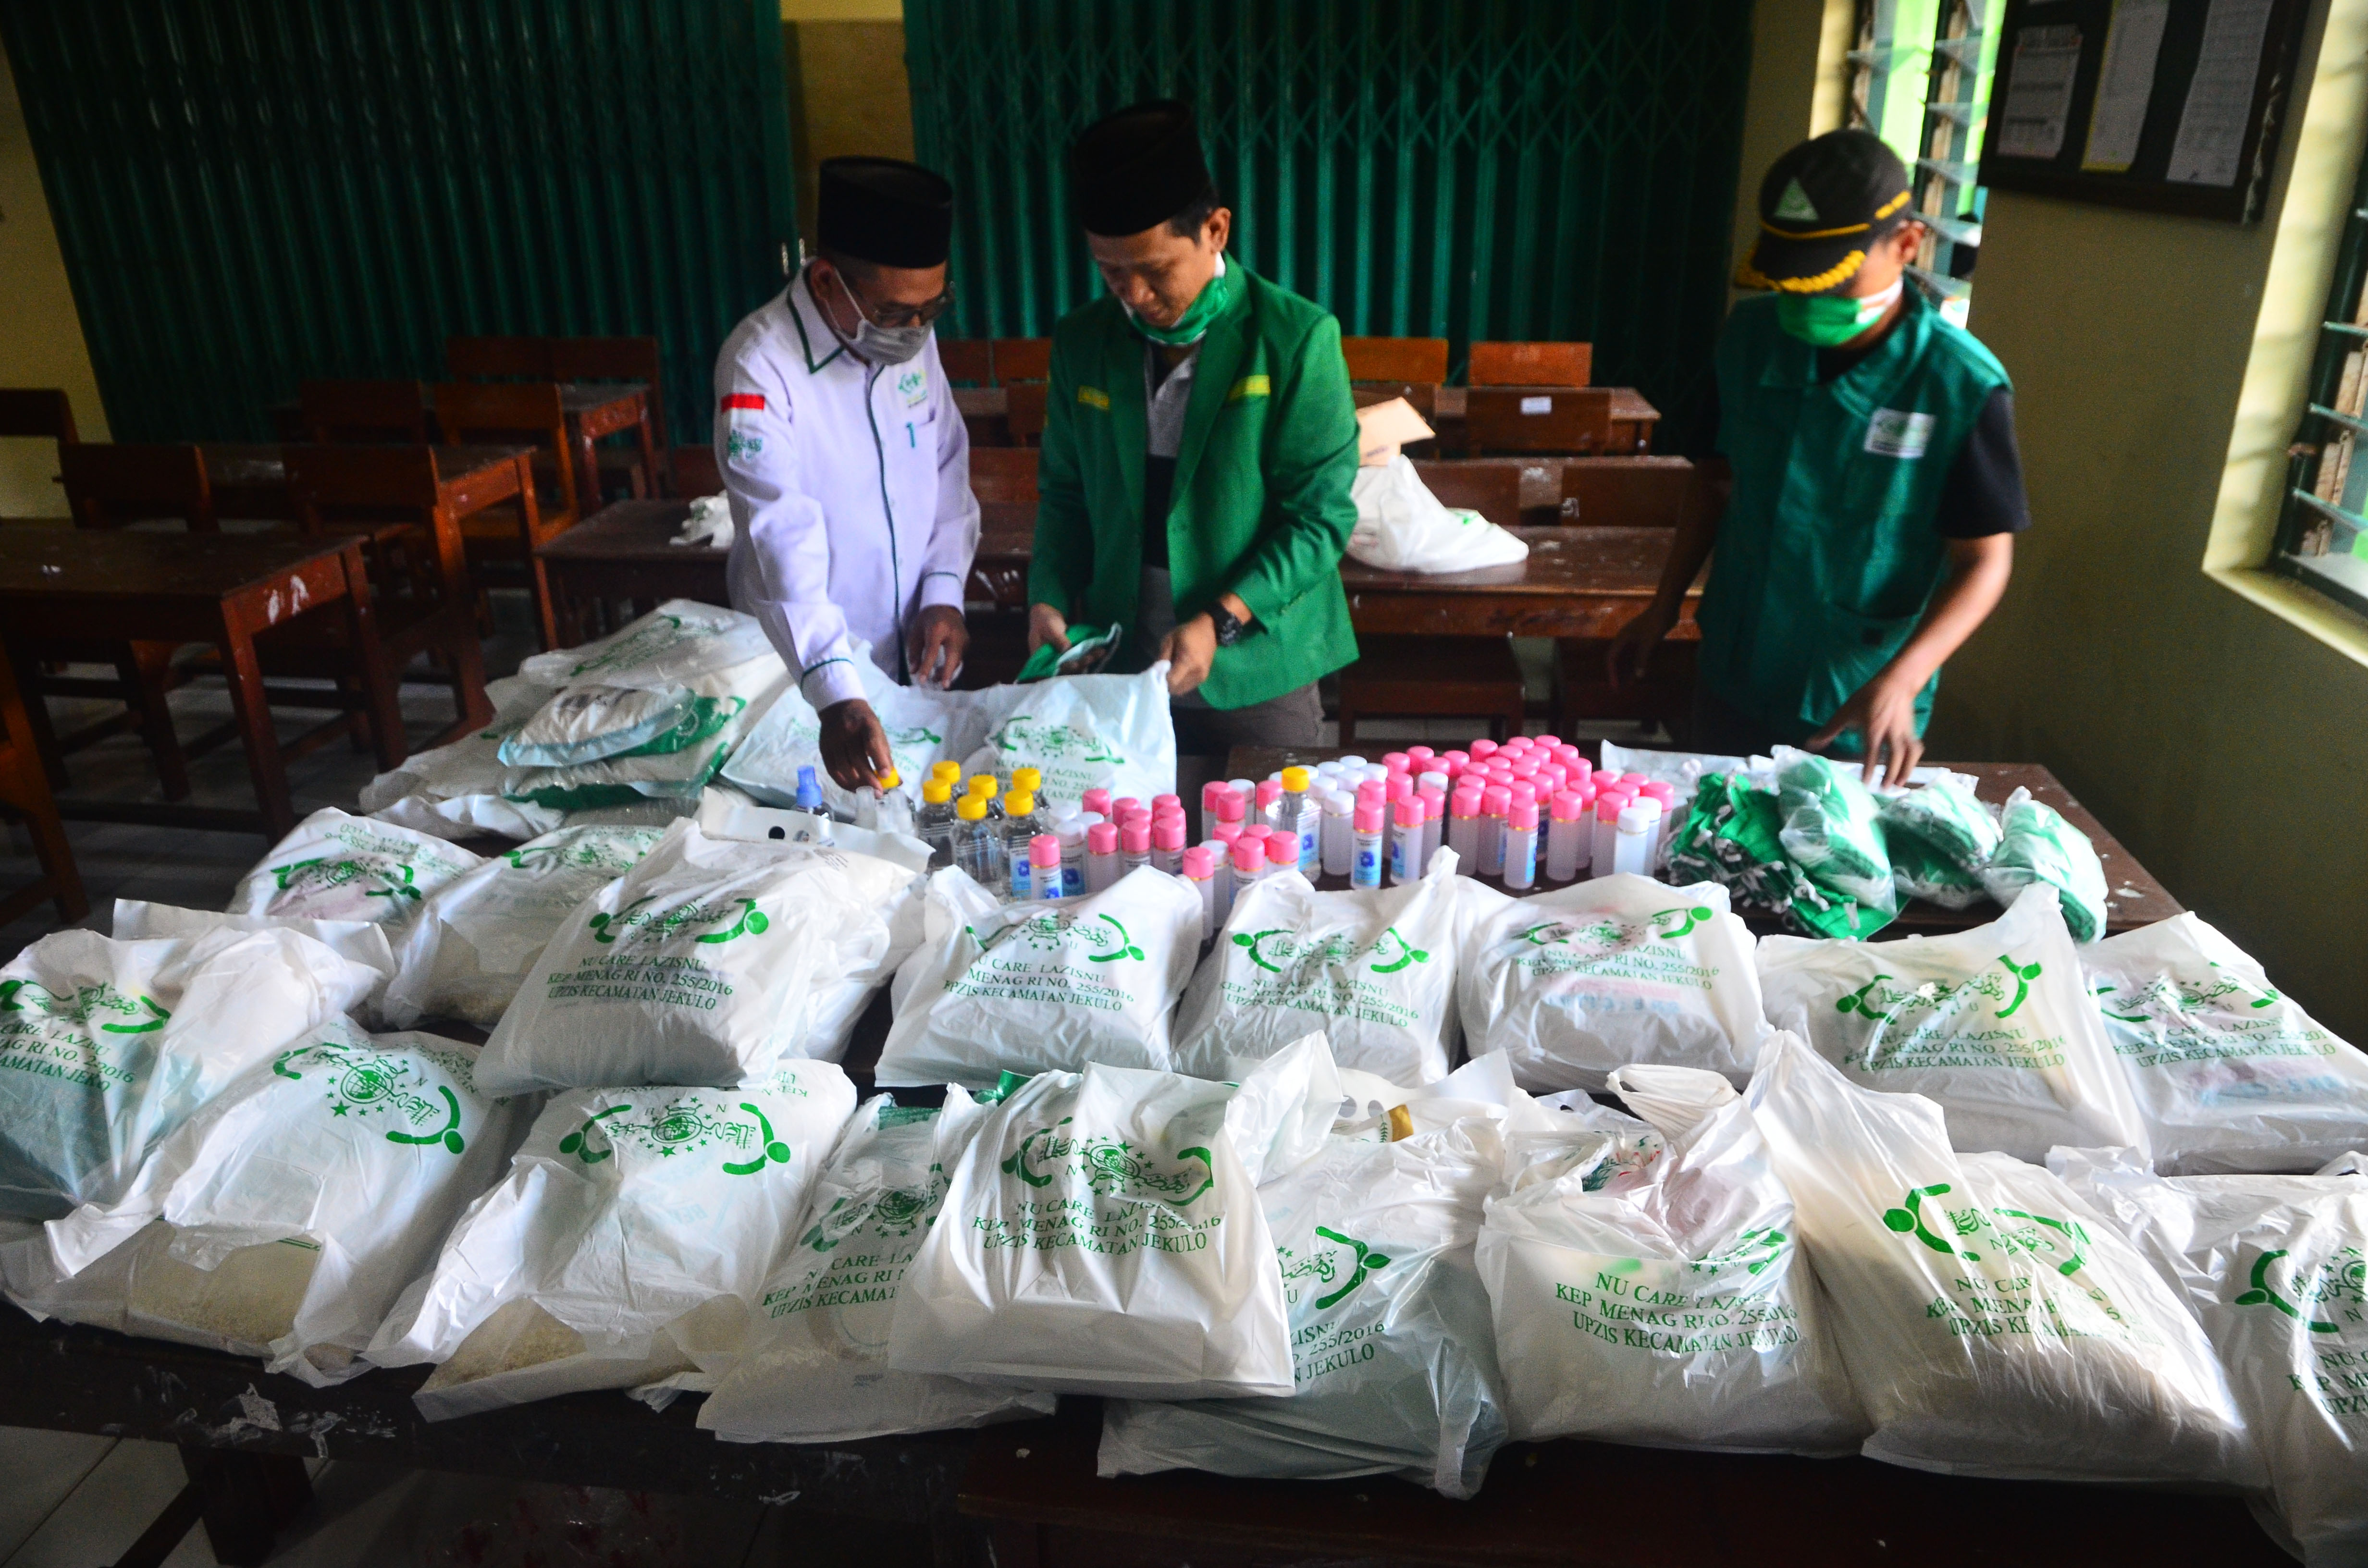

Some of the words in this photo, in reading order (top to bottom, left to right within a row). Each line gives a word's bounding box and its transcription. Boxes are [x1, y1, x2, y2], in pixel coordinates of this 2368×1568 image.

[598, 954, 635, 966] CARE
[639, 955, 707, 972] LAZISNU
[1633, 944, 1688, 960] AZISNU
[992, 958, 1032, 973] CARE
[1040, 964, 1106, 983] LAZISNU
[1575, 964, 1658, 981] KECAMATAN
[1662, 974, 1713, 991] JEKULO
[1615, 953, 1629, 967] RI
[1633, 956, 1658, 970] NO.
[1662, 962, 1720, 979] 255/2016
[547, 971, 572, 985] KEP
[574, 969, 622, 982] MENAG
[624, 969, 640, 981] RI
[642, 970, 666, 984] NO.
[670, 973, 733, 996] 255/2016
[967, 967, 1023, 986] MENAG
[1027, 976, 1042, 986] RI
[1046, 978, 1071, 989] NO.
[1076, 982, 1135, 1003] 255/2016
[1251, 978, 1273, 989] NU
[1323, 979, 1389, 997] LAZISNU
[548, 984, 579, 999] UPZIS
[580, 983, 657, 1001] KECAMATAN
[660, 990, 717, 1010] JEKULO
[982, 986, 1066, 1003] KECAMATAN
[1070, 994, 1122, 1011] JEKULO
[1221, 981, 1246, 993] KEP
[1313, 988, 1327, 999] RI
[1332, 991, 1356, 1003] NO.
[1361, 993, 1419, 1020] 255/2016
[1268, 996, 1353, 1017] KECAMATAN
[1356, 1007, 1408, 1029] JEKULO
[1902, 1028, 1946, 1040] CARE
[1955, 1026, 2028, 1041] LAZISNU
[26, 1041, 49, 1054] RI
[49, 1045, 78, 1062] NO.
[1883, 1042, 1944, 1056] MENAG
[1949, 1042, 1966, 1054] RI
[1971, 1043, 2002, 1054] NO.
[1907, 1056, 2003, 1067] KECAMATAN
[2007, 1053, 2065, 1069] JEKULO
[2113, 1042, 2146, 1055] KEP
[2136, 1052, 2182, 1068] UPZIS
[2184, 1042, 2277, 1060] KECAMATAN
[1015, 1200, 1042, 1215] NU
[1046, 1198, 1095, 1220] CARE
[972, 1215, 1010, 1232] KEP
[1016, 1216, 1085, 1233] MENAG
[1089, 1224, 1110, 1238] RI
[1114, 1217, 1143, 1237] NO.
[983, 1233, 1029, 1250] UPZIS
[1033, 1232, 1139, 1256] KECAMATAN
[1141, 1232, 1207, 1253] JEKULO
[831, 1254, 881, 1271] CARE
[762, 1286, 797, 1306] KEP
[873, 1269, 893, 1283] RI
[1595, 1272, 1630, 1296] NU
[1633, 1285, 1689, 1307] CARE
[1954, 1276, 1988, 1292] NU
[1994, 1276, 2034, 1293] CAR
[770, 1296, 813, 1319] UPZIS
[815, 1286, 900, 1307] KECAMAT
[1555, 1282, 1592, 1308] KEP
[1599, 1298, 1678, 1327] MENAG
[1308, 1320, 1385, 1356] 255/2016
[1572, 1310, 1619, 1345] UPZIS
[1623, 1328, 1733, 1354] KECAMATAN
[1949, 1316, 2003, 1336] UPZIS
[1307, 1343, 1375, 1380] JEKULO
[2319, 1351, 2356, 1368] NU
